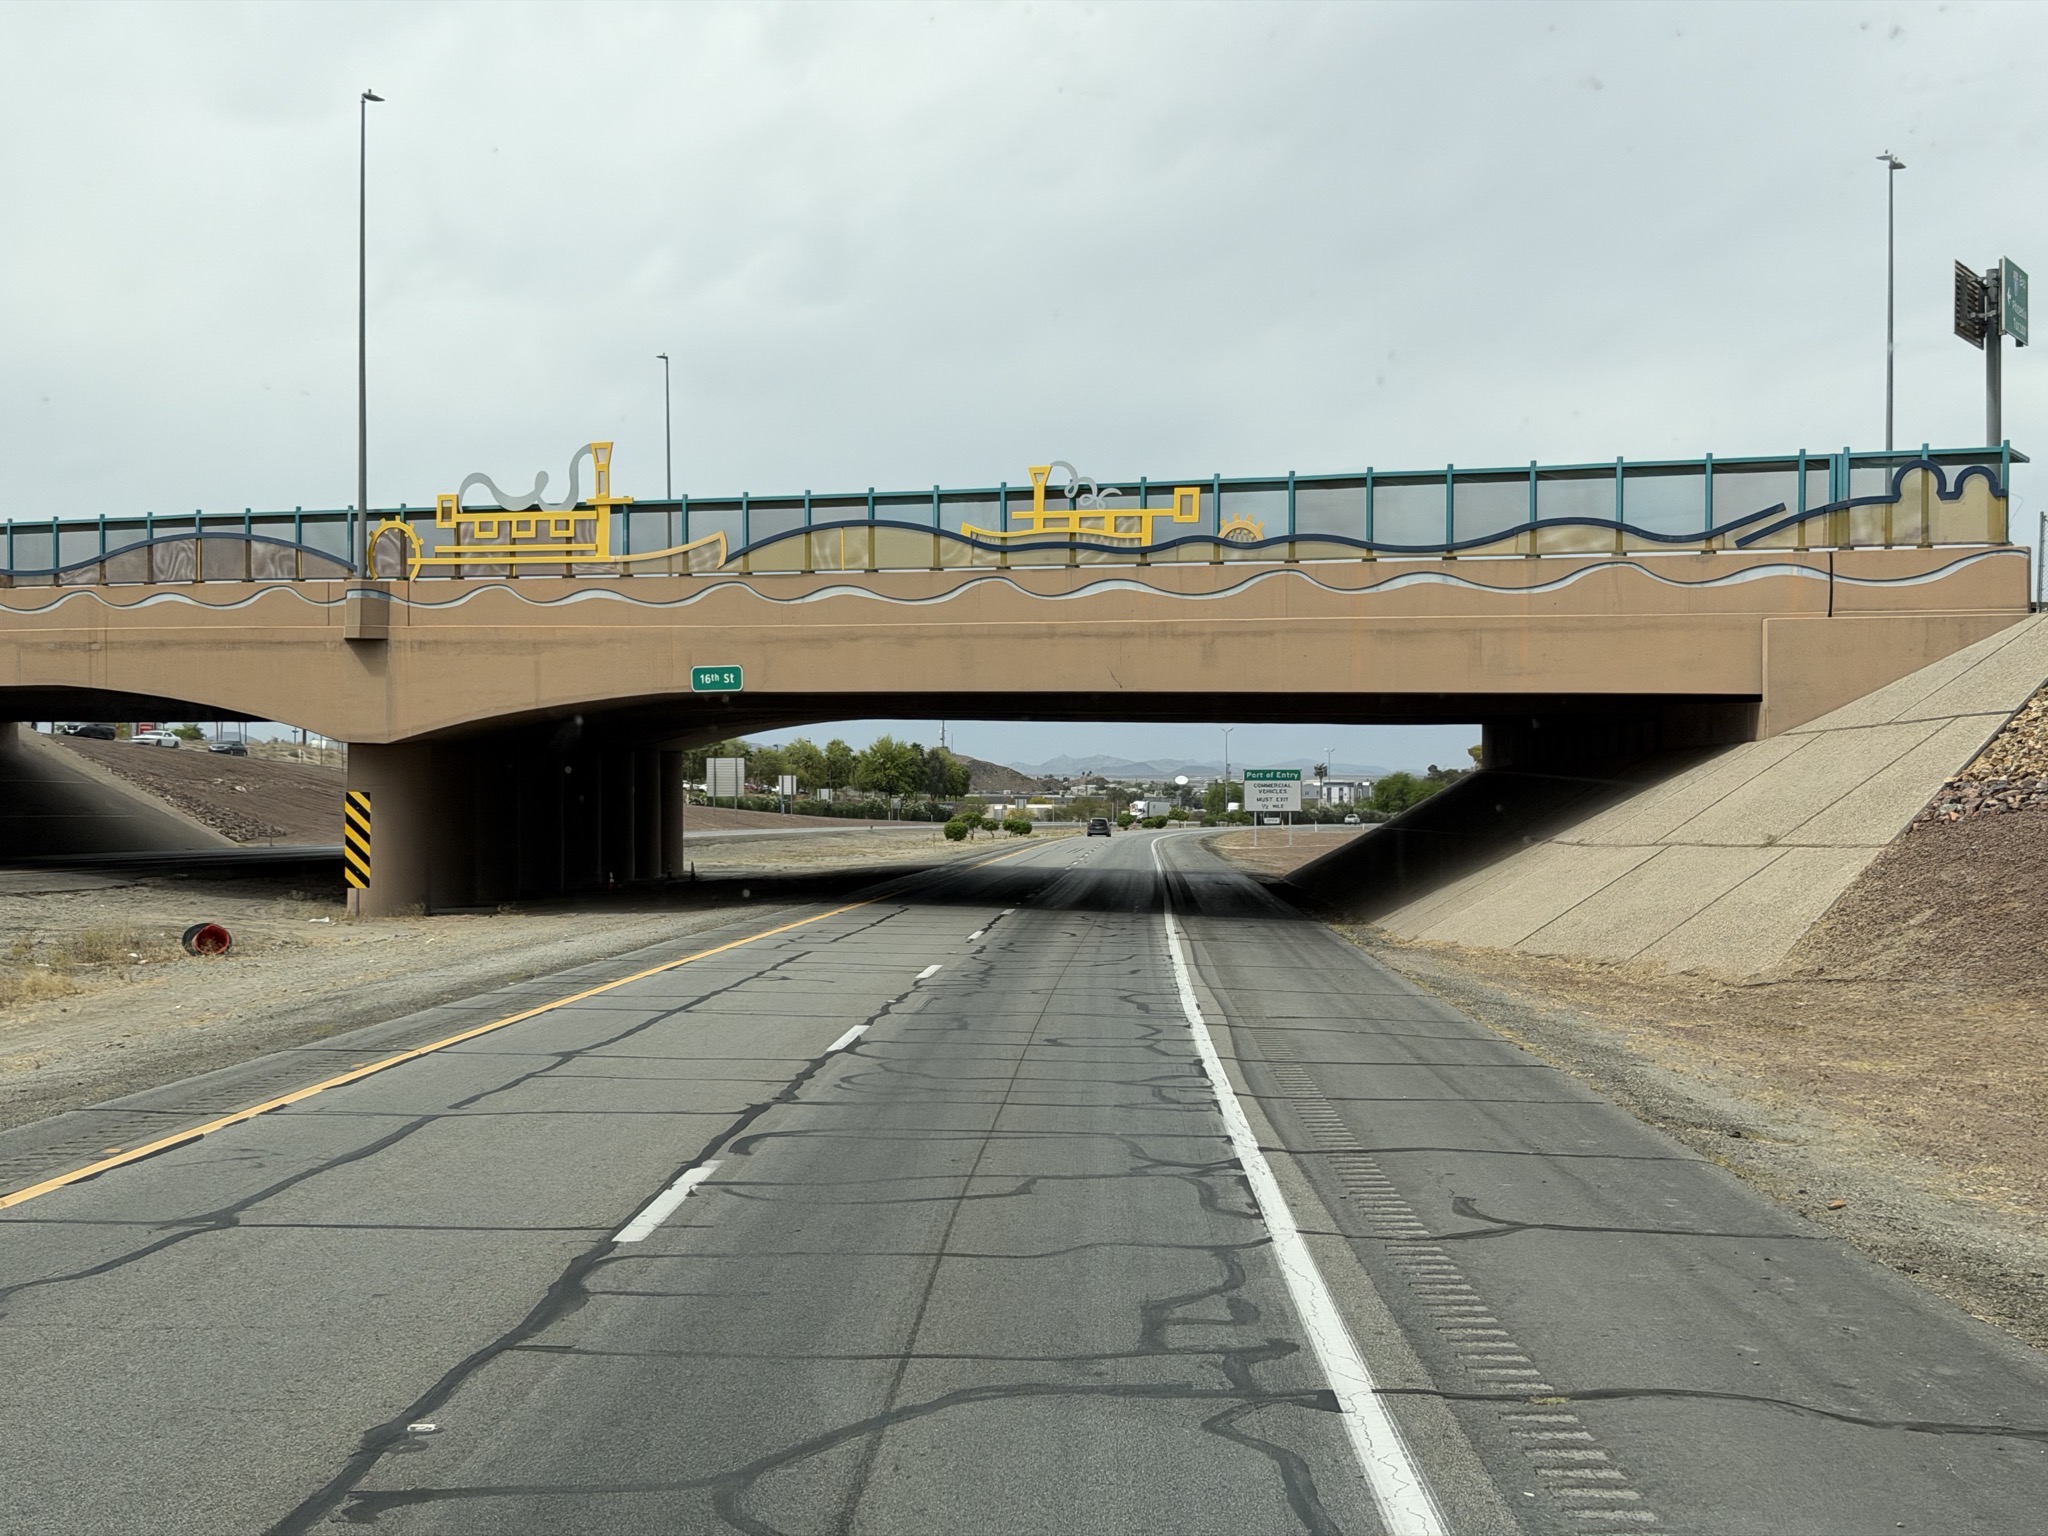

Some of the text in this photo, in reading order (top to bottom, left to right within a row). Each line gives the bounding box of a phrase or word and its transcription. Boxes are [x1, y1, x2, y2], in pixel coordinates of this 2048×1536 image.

[700, 673, 735, 684] 16th St
[1276, 772, 1298, 780] Entry
